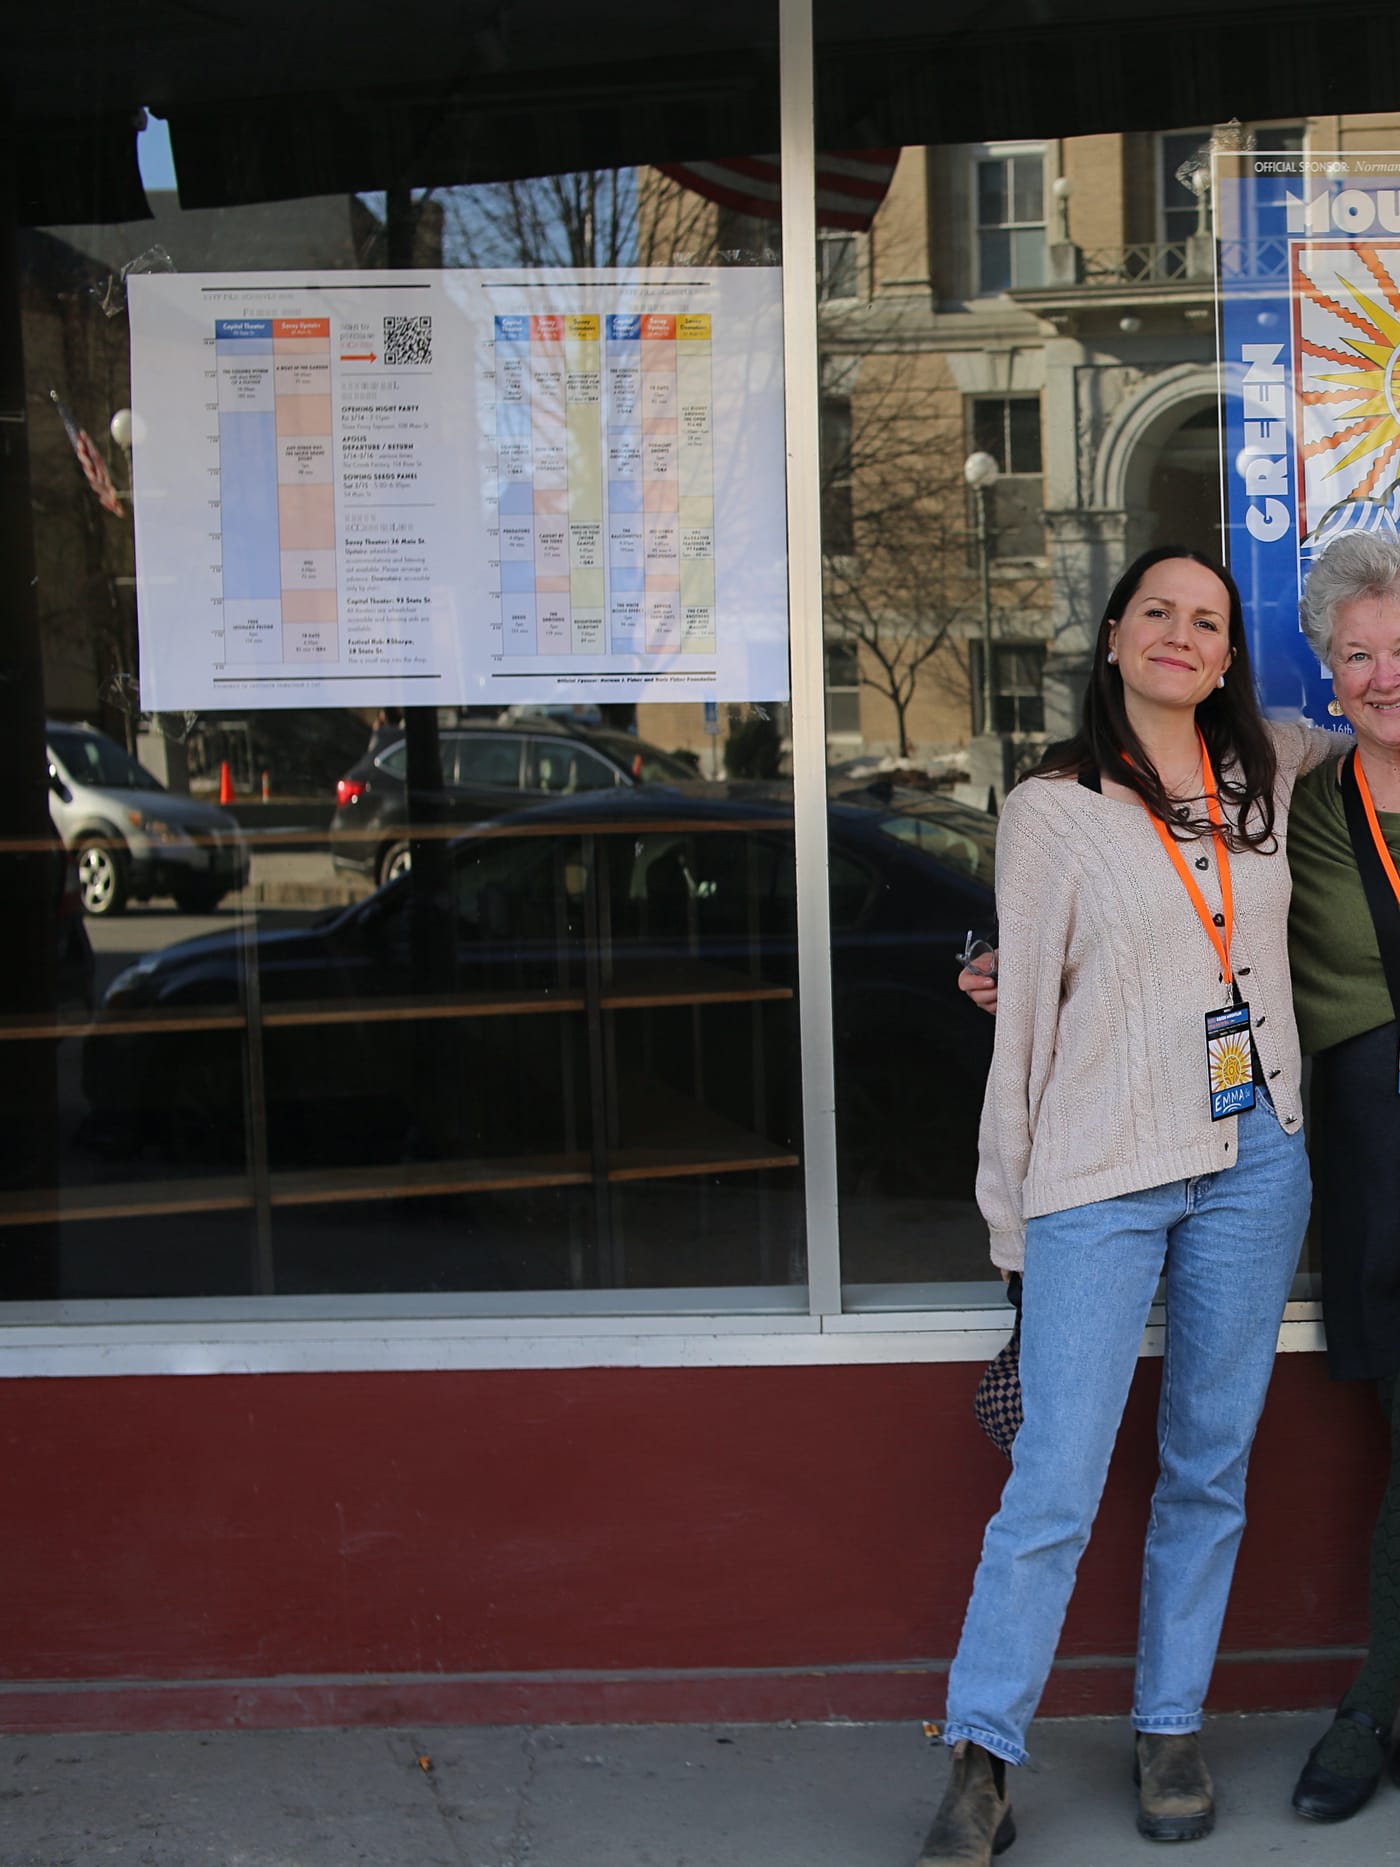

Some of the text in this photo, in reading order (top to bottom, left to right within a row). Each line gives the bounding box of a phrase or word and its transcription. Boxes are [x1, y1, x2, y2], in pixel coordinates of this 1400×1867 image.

[1254, 161, 1296, 173] OFFICIAL
[1354, 160, 1400, 172] Norman
[1241, 343, 1290, 542] GREEN
[343, 473, 372, 481] SOWING
[397, 472, 418, 480] PANEL
[345, 538, 363, 546] Savoy
[347, 597, 369, 605] Capitol
[406, 596, 422, 604] State
[358, 647, 374, 655] State
[1215, 1088, 1245, 1112] EMMA
